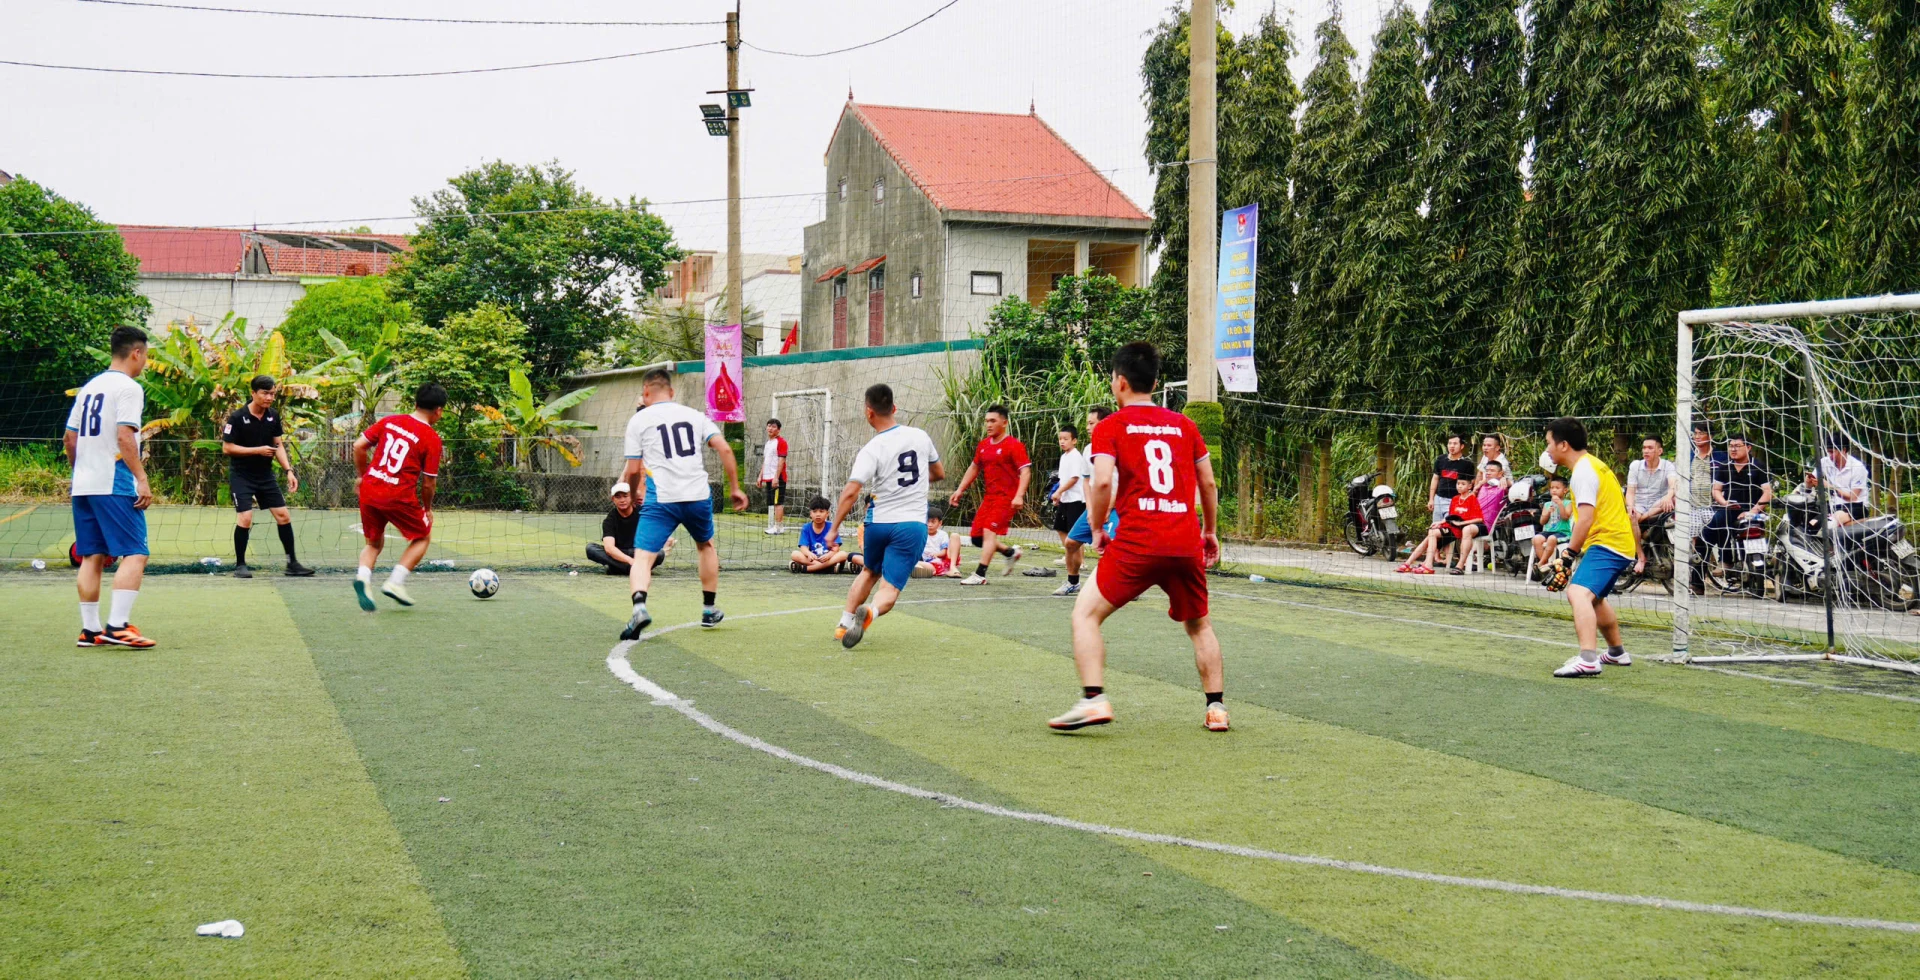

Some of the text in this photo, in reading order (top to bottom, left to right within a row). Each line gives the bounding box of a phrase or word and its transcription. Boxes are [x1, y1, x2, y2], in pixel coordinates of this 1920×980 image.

[80, 393, 105, 437] 18
[379, 432, 410, 474] 19
[656, 421, 696, 459] 10
[897, 450, 920, 487] 9
[1144, 439, 1174, 495] 8
